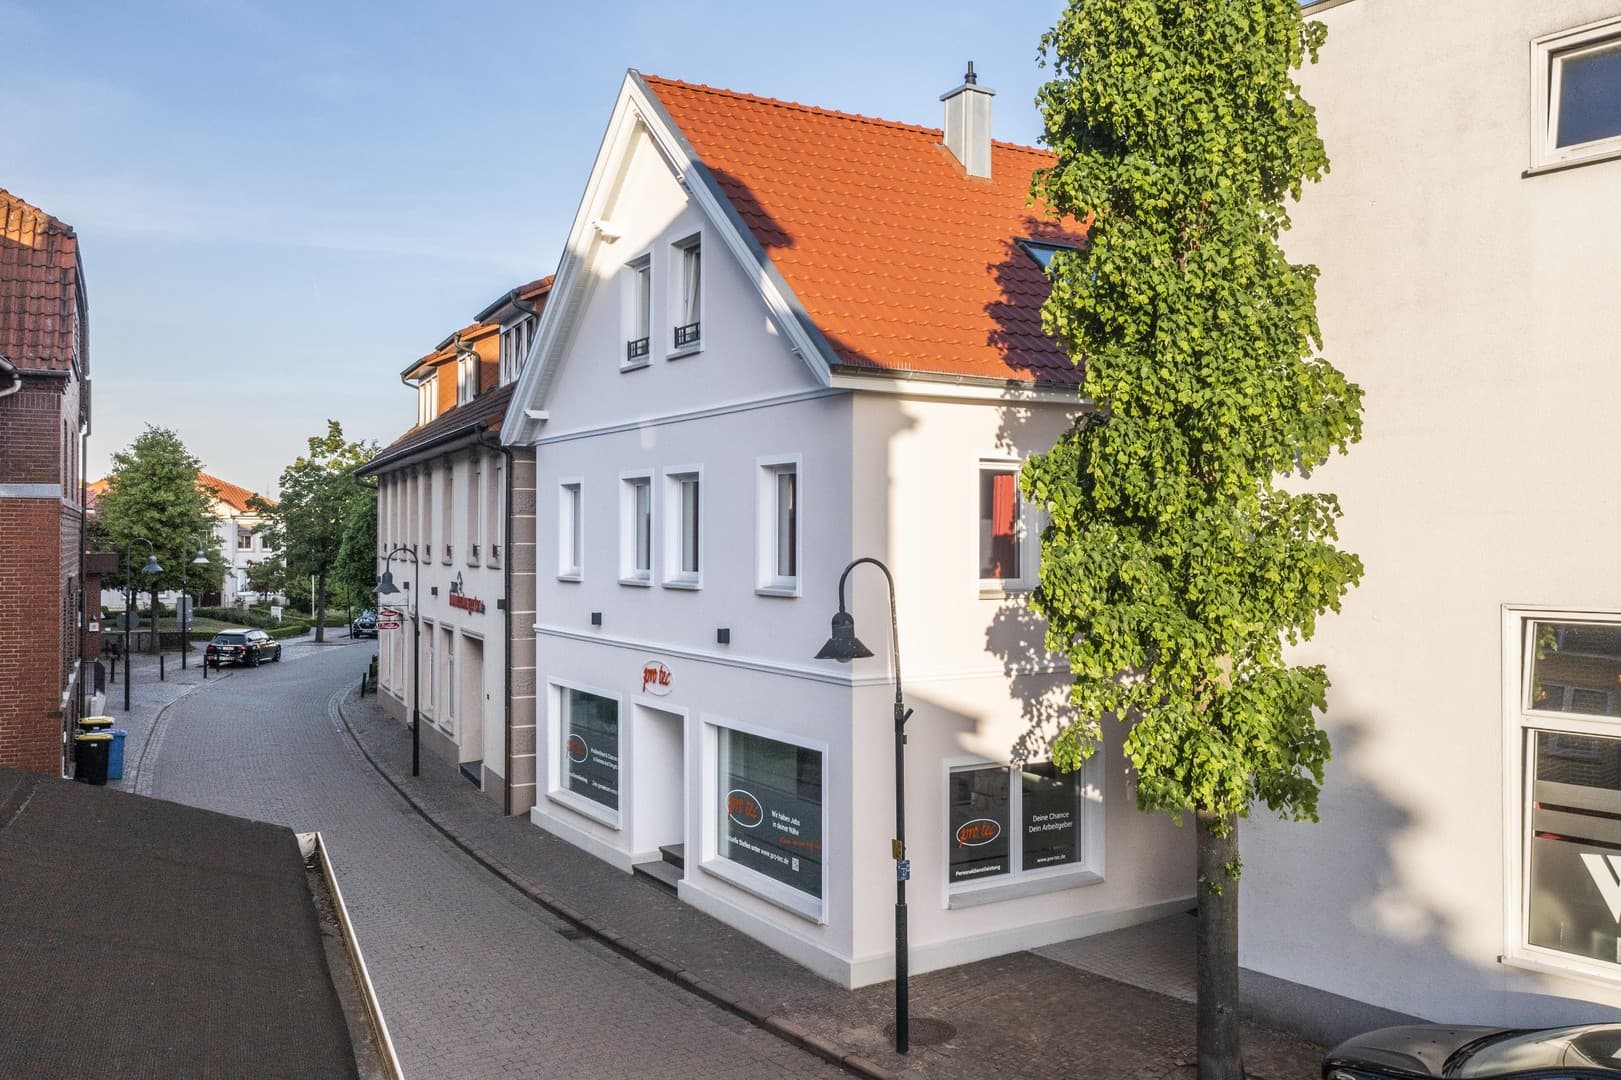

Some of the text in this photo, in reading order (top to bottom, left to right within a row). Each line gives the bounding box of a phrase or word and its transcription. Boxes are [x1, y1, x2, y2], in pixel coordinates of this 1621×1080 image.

[643, 664, 670, 692] pro tec
[1032, 811, 1070, 822] Deine Chance
[1028, 820, 1073, 833] Dein Arbeitgeber
[955, 866, 1001, 876] Personaldienstleistung
